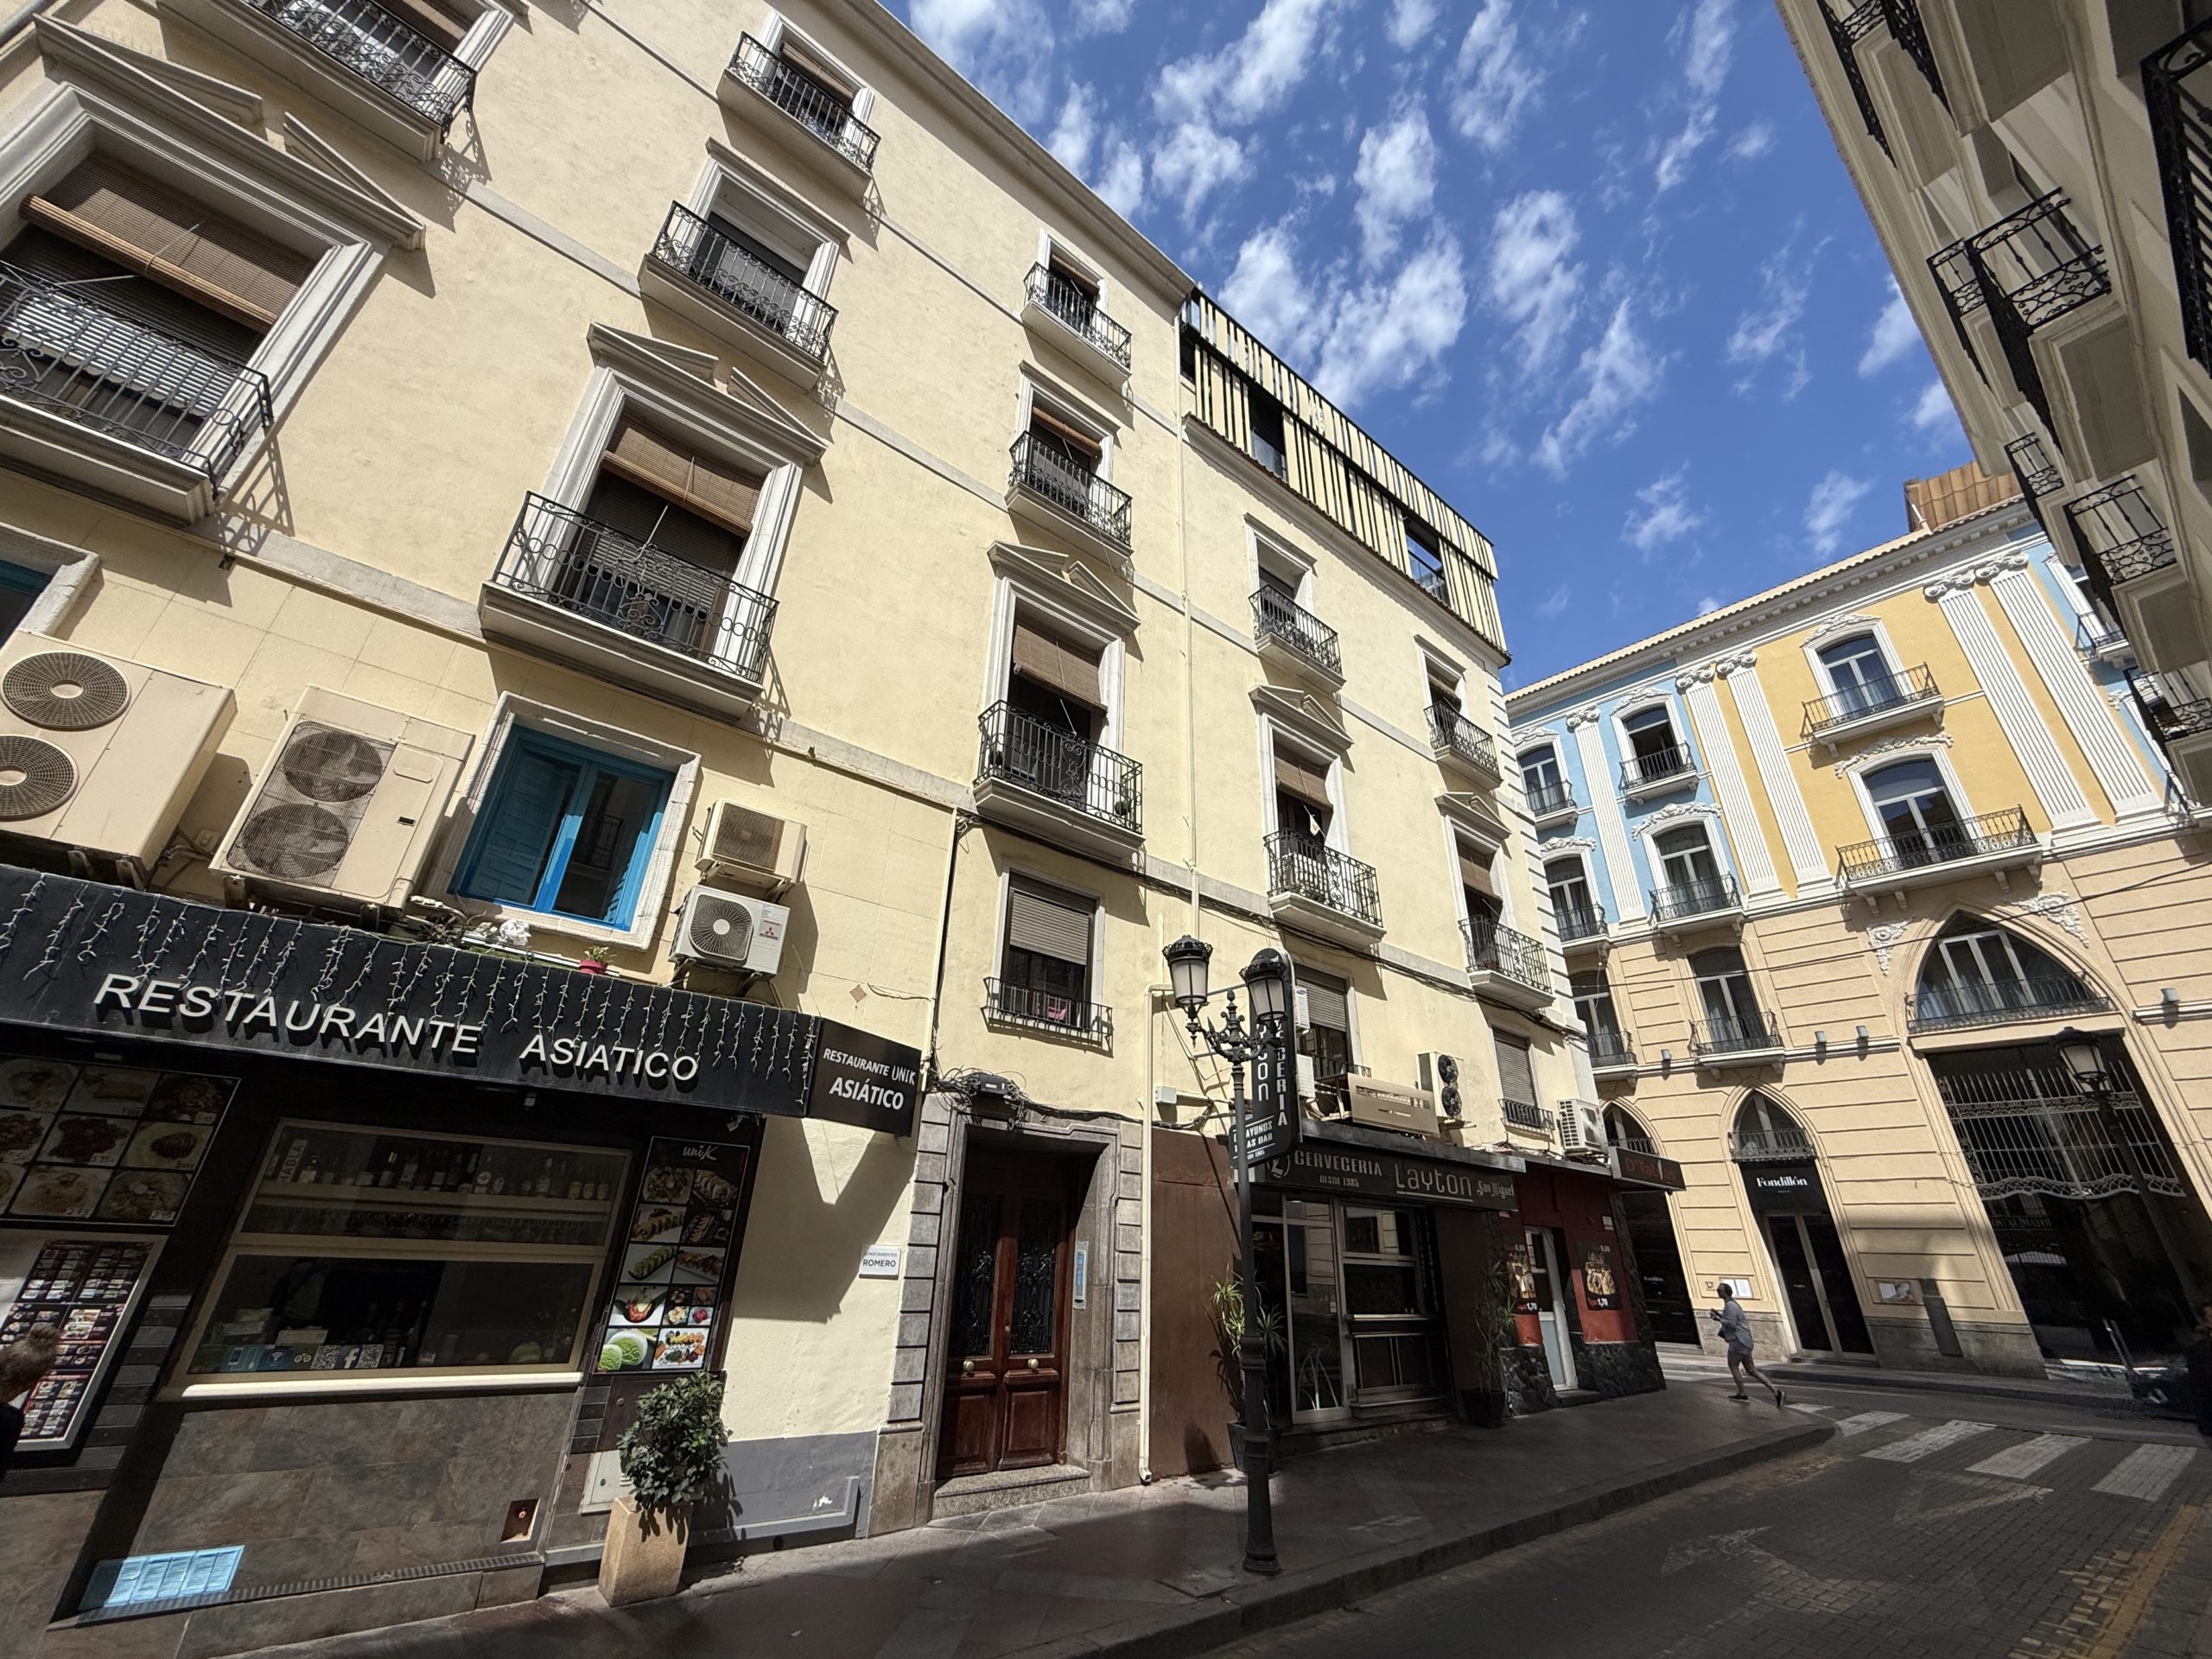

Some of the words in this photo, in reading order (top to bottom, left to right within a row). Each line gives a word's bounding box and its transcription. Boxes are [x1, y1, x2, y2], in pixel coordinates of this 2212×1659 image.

[93, 974, 484, 1053] RESTAURANTE
[519, 1034, 699, 1081] ASIATICO
[823, 1047, 890, 1077] RESTAURANTE
[891, 1065, 916, 1086] UNIK
[829, 1077, 904, 1110] ASIÁTICO
[1294, 1149, 1383, 1177] CERVECERIA
[1395, 1163, 1472, 1197] Layton
[862, 1259, 896, 1268] ROMERO
